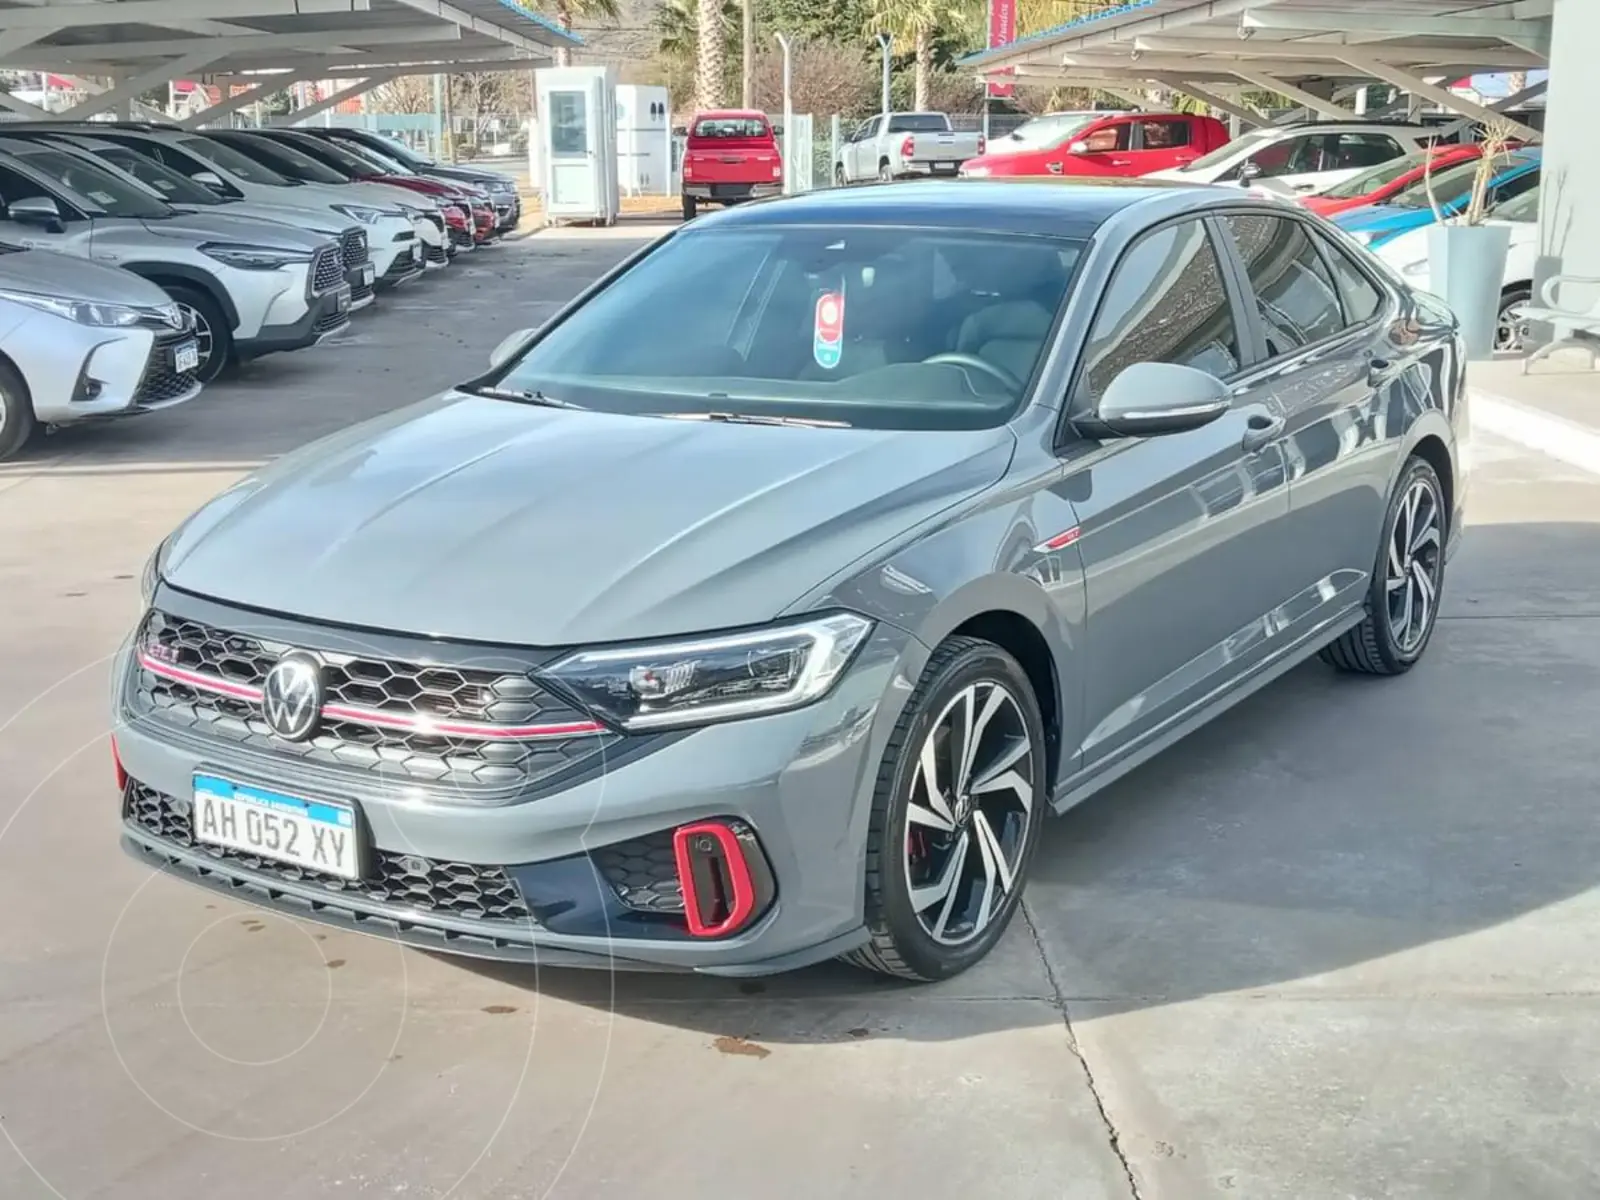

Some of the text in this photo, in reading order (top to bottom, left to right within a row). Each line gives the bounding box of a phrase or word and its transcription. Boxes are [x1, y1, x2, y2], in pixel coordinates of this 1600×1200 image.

[203, 798, 237, 841] AH
[246, 809, 301, 856] 052
[311, 824, 345, 868] XY
